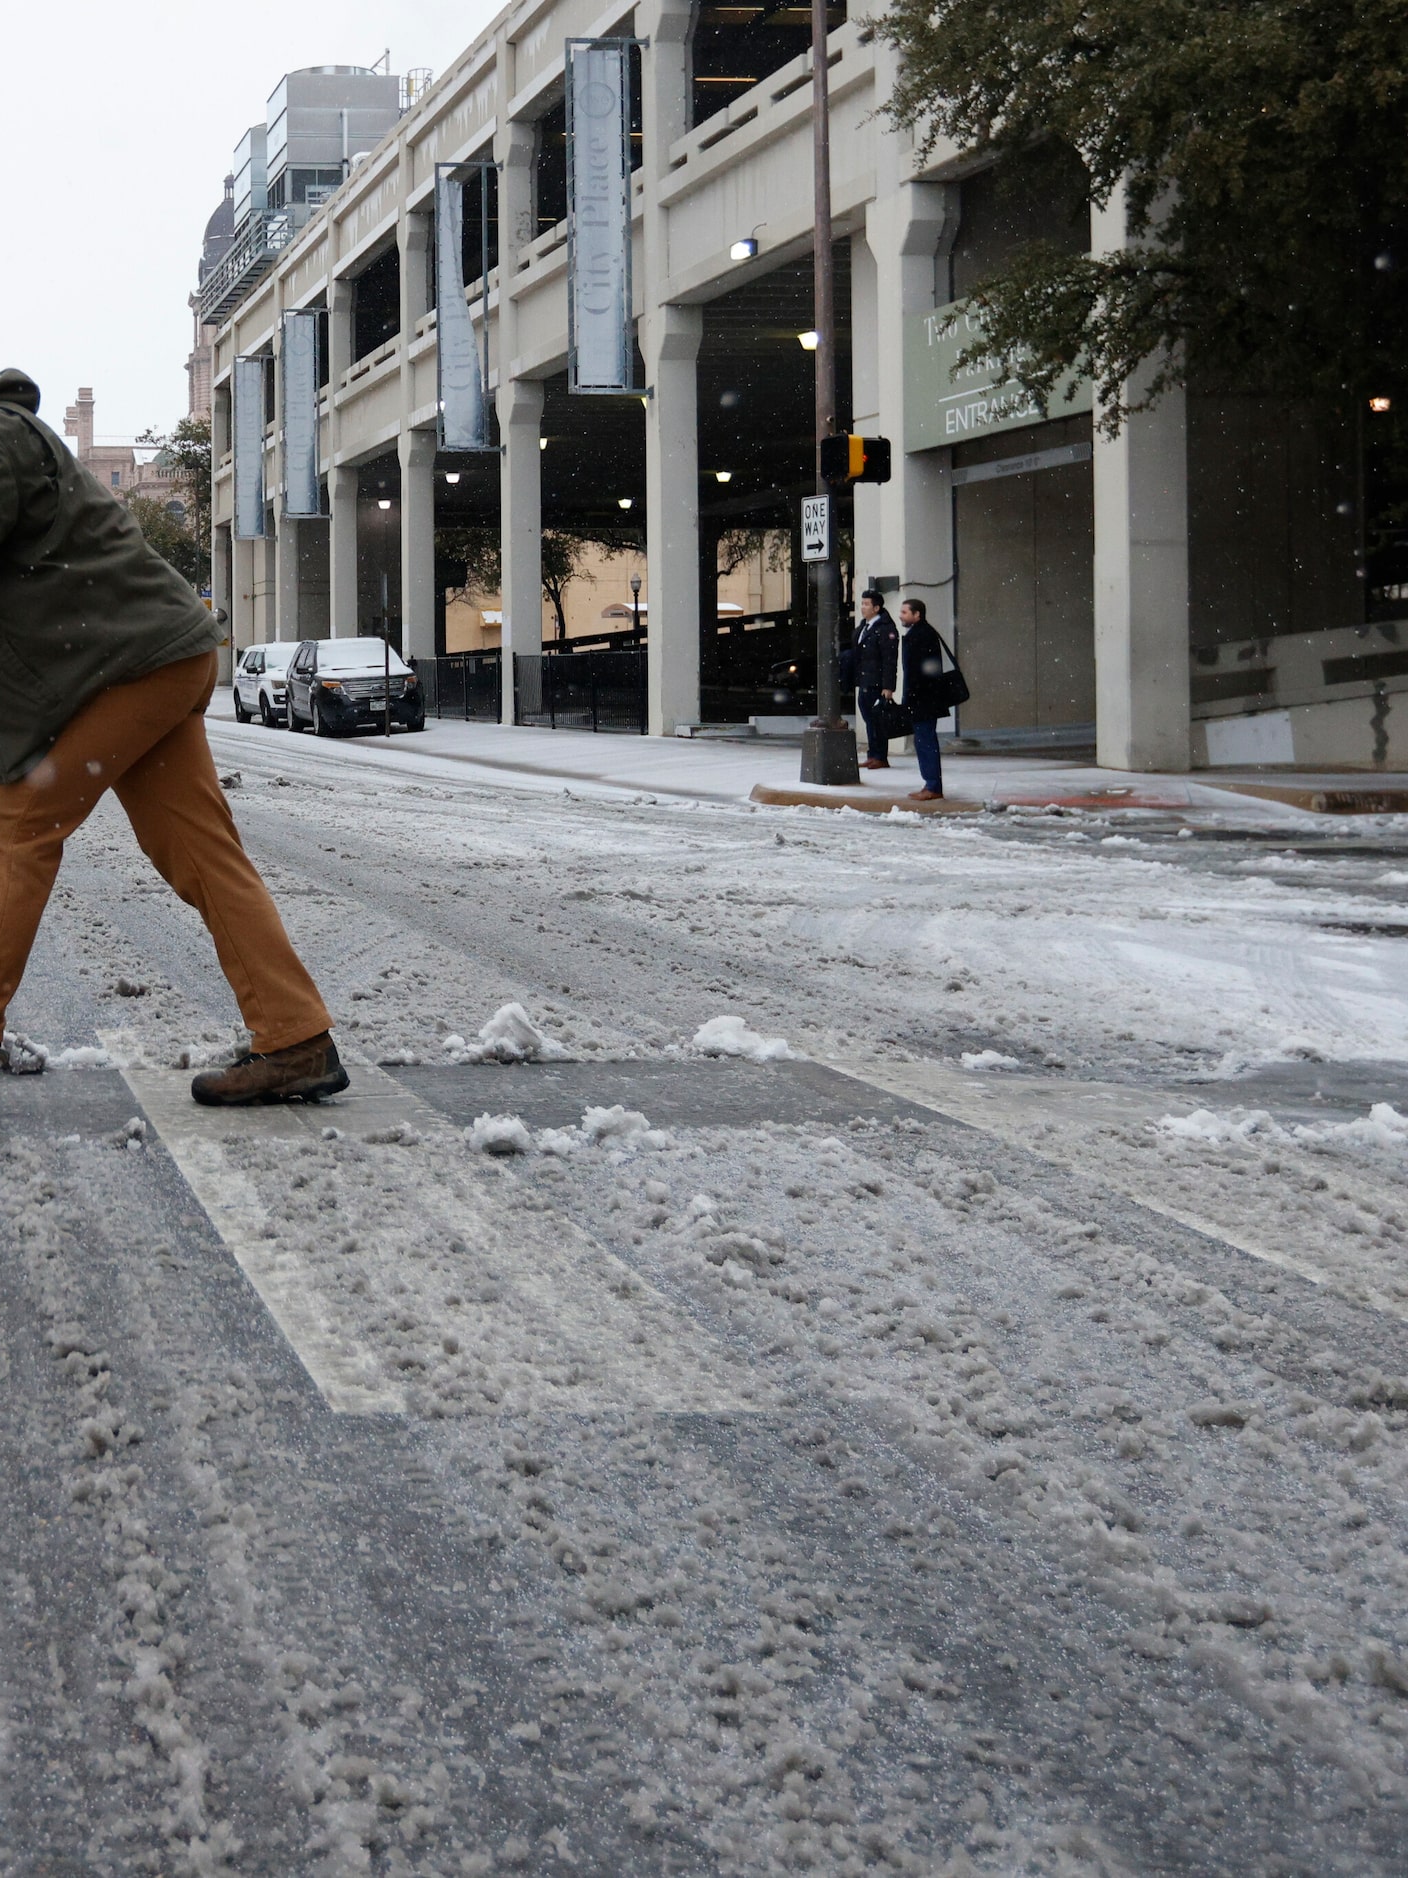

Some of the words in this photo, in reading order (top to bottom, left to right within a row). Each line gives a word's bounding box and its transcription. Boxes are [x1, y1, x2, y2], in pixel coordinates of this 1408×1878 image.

[580, 137, 610, 228] Place
[582, 249, 619, 316] City
[804, 502, 826, 519] ONE
[804, 520, 826, 536] WAY
